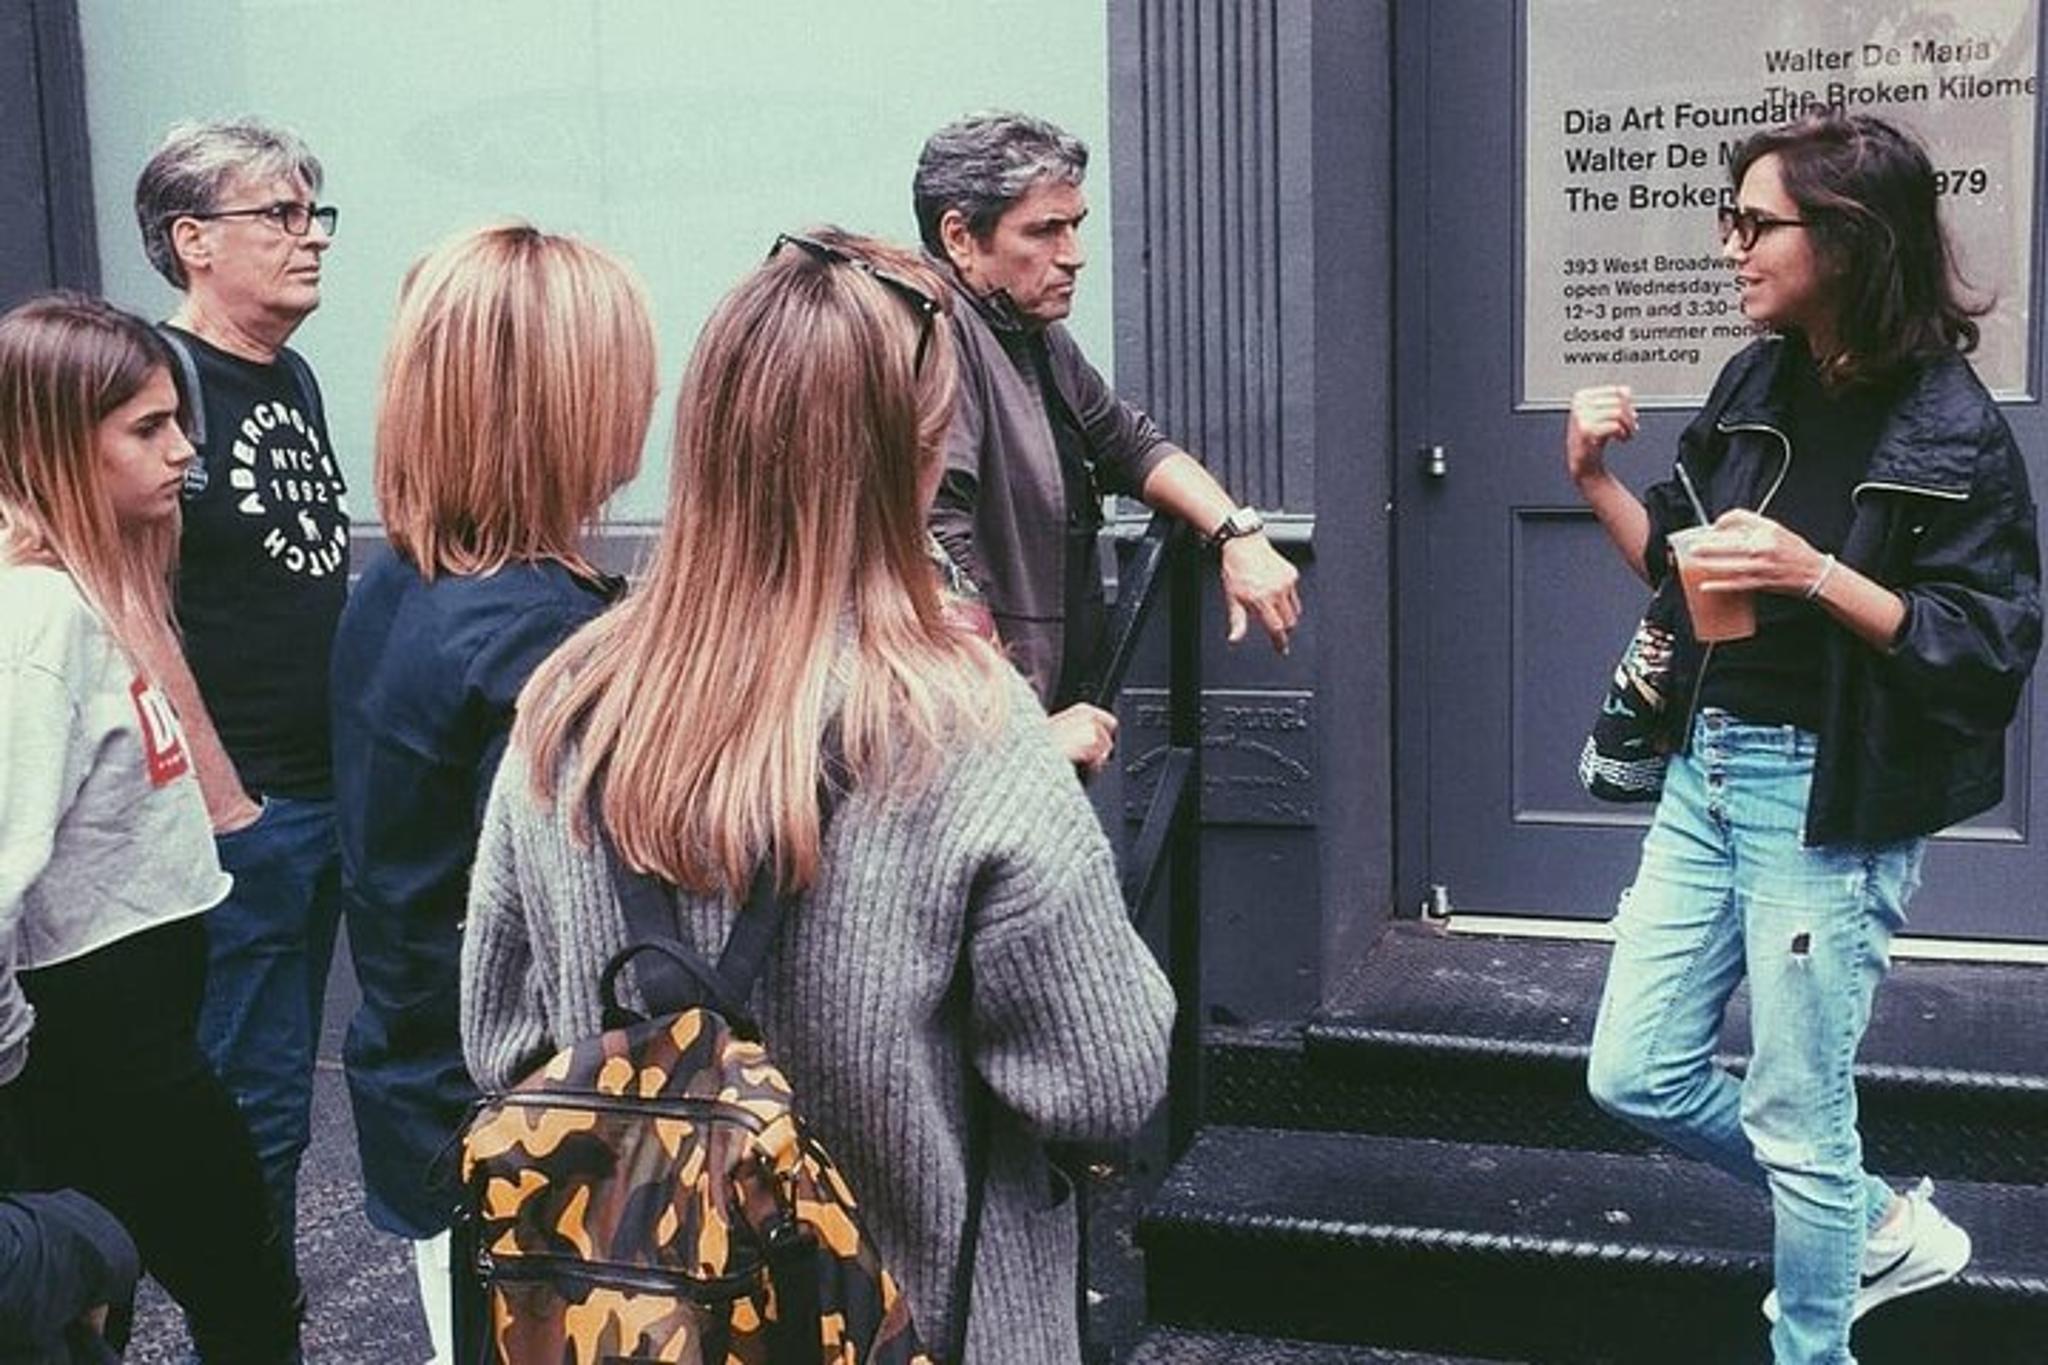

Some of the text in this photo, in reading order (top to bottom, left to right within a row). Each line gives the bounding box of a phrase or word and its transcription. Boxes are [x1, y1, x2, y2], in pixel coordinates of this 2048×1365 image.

[1766, 39, 1990, 73] Walter De Maria
[1764, 74, 2036, 109] The Broken Kilome
[1564, 109, 1611, 134] Dia
[1621, 105, 1664, 131] Art
[1565, 146, 1657, 173] Walter
[1667, 144, 1708, 168] De
[1565, 169, 1986, 212] The Broken 979
[1564, 255, 1736, 276] 393 West Broadwa
[1564, 283, 1610, 298] open
[1612, 305, 1641, 321] pm
[1646, 301, 1681, 317] and
[1564, 326, 1624, 342] closed
[1630, 324, 1706, 341] summer
[1564, 347, 1700, 365] www.diaart.org
[271, 448, 314, 472] NYC
